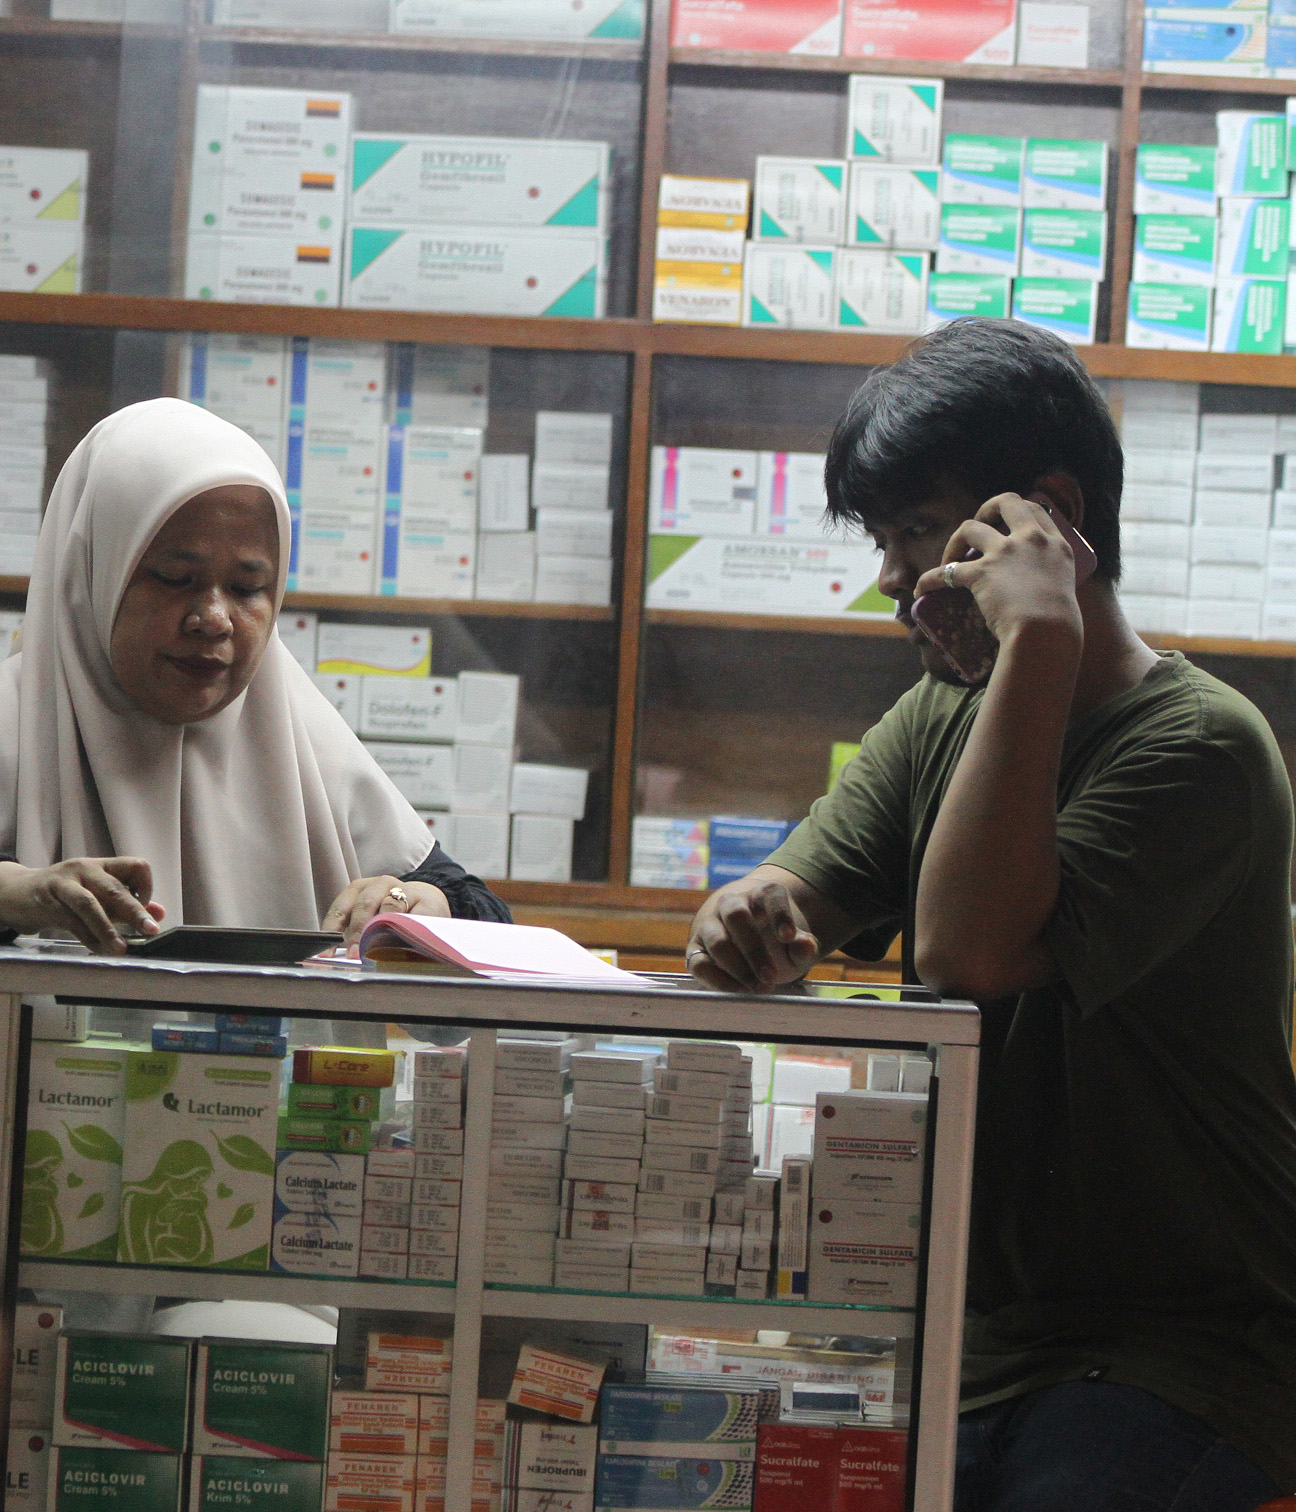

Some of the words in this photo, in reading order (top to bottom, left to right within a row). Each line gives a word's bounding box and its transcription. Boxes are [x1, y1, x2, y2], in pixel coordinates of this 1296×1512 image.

[421, 150, 506, 167] HYPOFIL
[419, 240, 505, 257] HYPOFIL
[38, 1089, 116, 1108] Lactamor
[188, 1099, 265, 1118] Lactamor
[826, 1140, 879, 1150] GENTAMICIN
[285, 1175, 323, 1190] Calcium
[324, 1178, 358, 1191] Lactate
[280, 1235, 318, 1249] Calcium
[320, 1237, 353, 1251] Lactate
[823, 1245, 876, 1255] GENTAMICIN
[73, 1360, 155, 1376] ACICLOVIR
[534, 1360, 584, 1380] FENAREN
[72, 1373, 107, 1385] Cream
[110, 1375, 127, 1387] 5%
[214, 1370, 296, 1385] ACICLOVIR
[213, 1383, 247, 1395] Cream
[249, 1384, 268, 1396] 5%
[347, 1402, 399, 1412] FENAREN
[345, 1463, 397, 1473] FENAREN
[760, 1454, 820, 1468] Sucralfate
[840, 1458, 900, 1473] Sucralfate
[64, 1470, 146, 1485] ACICLOVIR
[527, 1465, 587, 1477] IBUPROFEN
[63, 1483, 98, 1496] Cream
[101, 1485, 118, 1497] 5%
[207, 1480, 289, 1495] ACICLOVIR
[206, 1491, 234, 1503] Krim
[235, 1493, 252, 1505] 5%
